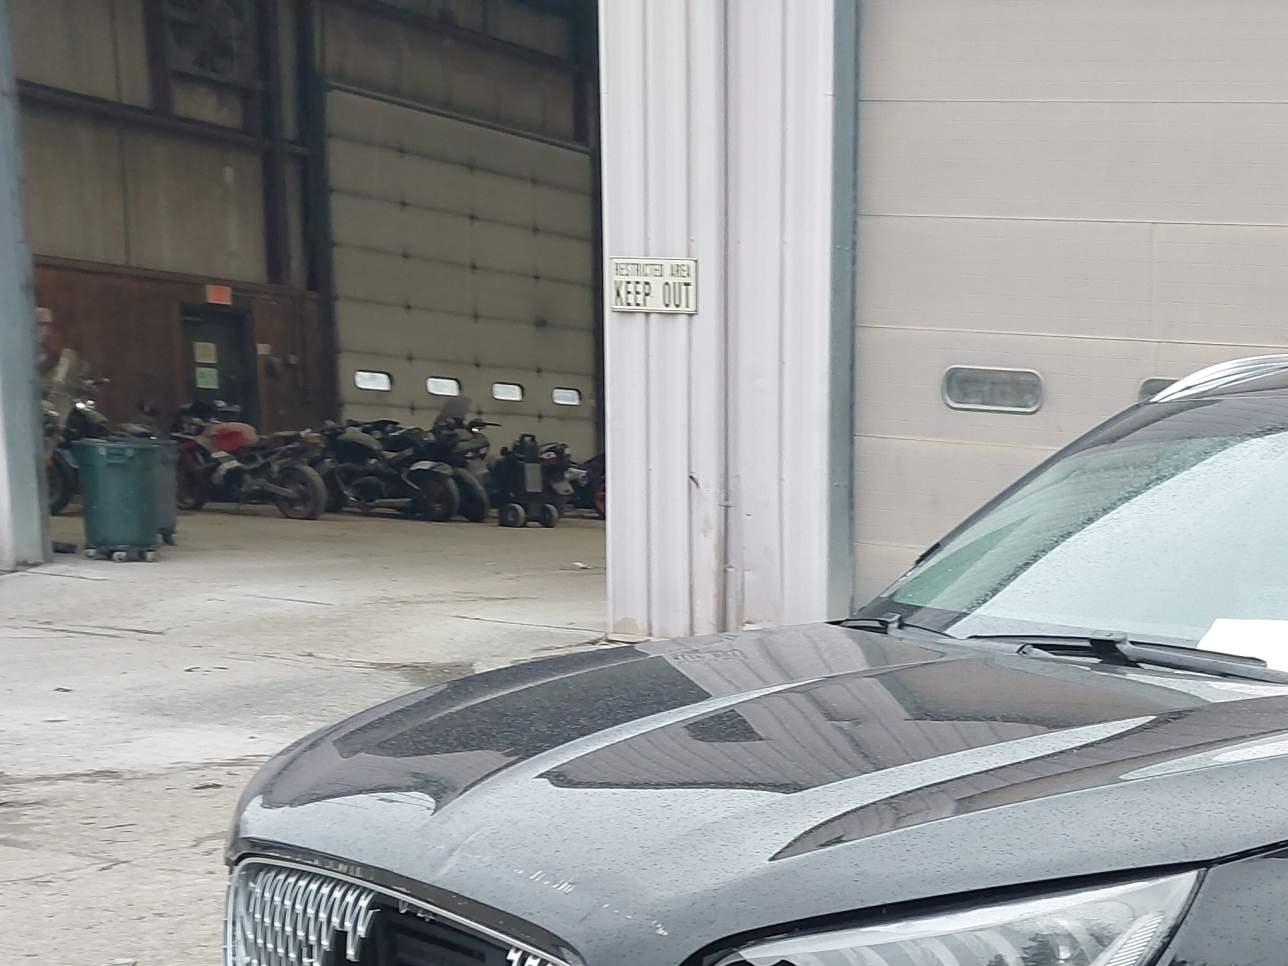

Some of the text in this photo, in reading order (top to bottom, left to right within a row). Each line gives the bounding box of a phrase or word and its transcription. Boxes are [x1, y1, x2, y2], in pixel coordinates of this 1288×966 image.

[615, 262, 690, 278] RESTRICTED AREA
[615, 280, 691, 308] KEEP OUT
